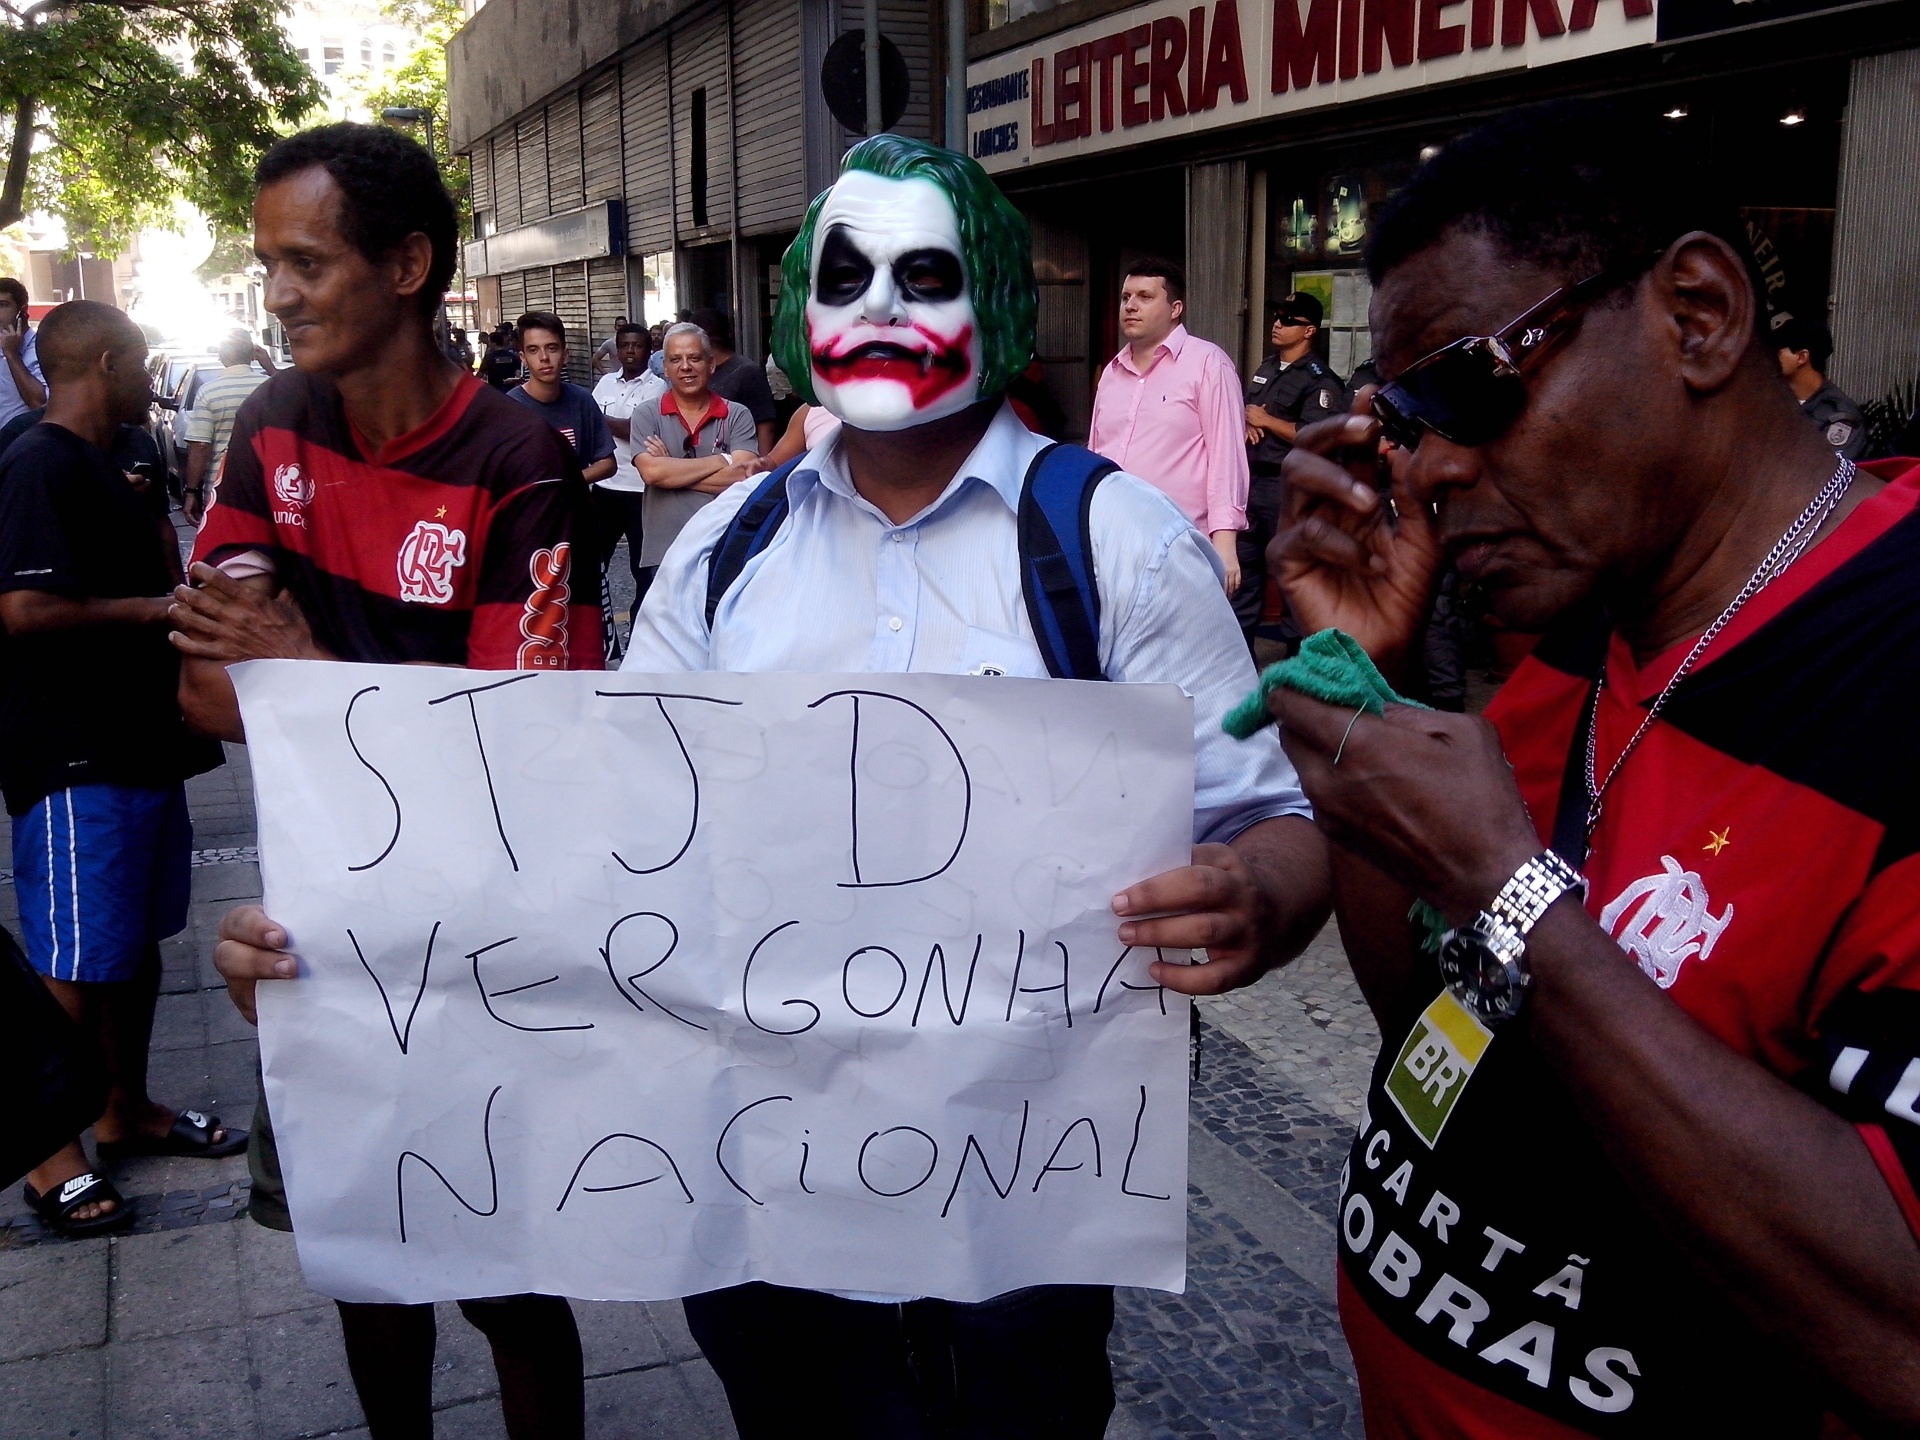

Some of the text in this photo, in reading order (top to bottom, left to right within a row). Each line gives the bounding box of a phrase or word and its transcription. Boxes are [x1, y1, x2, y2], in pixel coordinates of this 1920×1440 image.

[967, 68, 1030, 114] ESTAURANTE
[1031, 0, 1652, 147] LEITERIA MINE
[346, 911, 1168, 1055] VERGONHA
[1403, 1030, 1467, 1108] BR
[64, 1173, 94, 1195] NIKE
